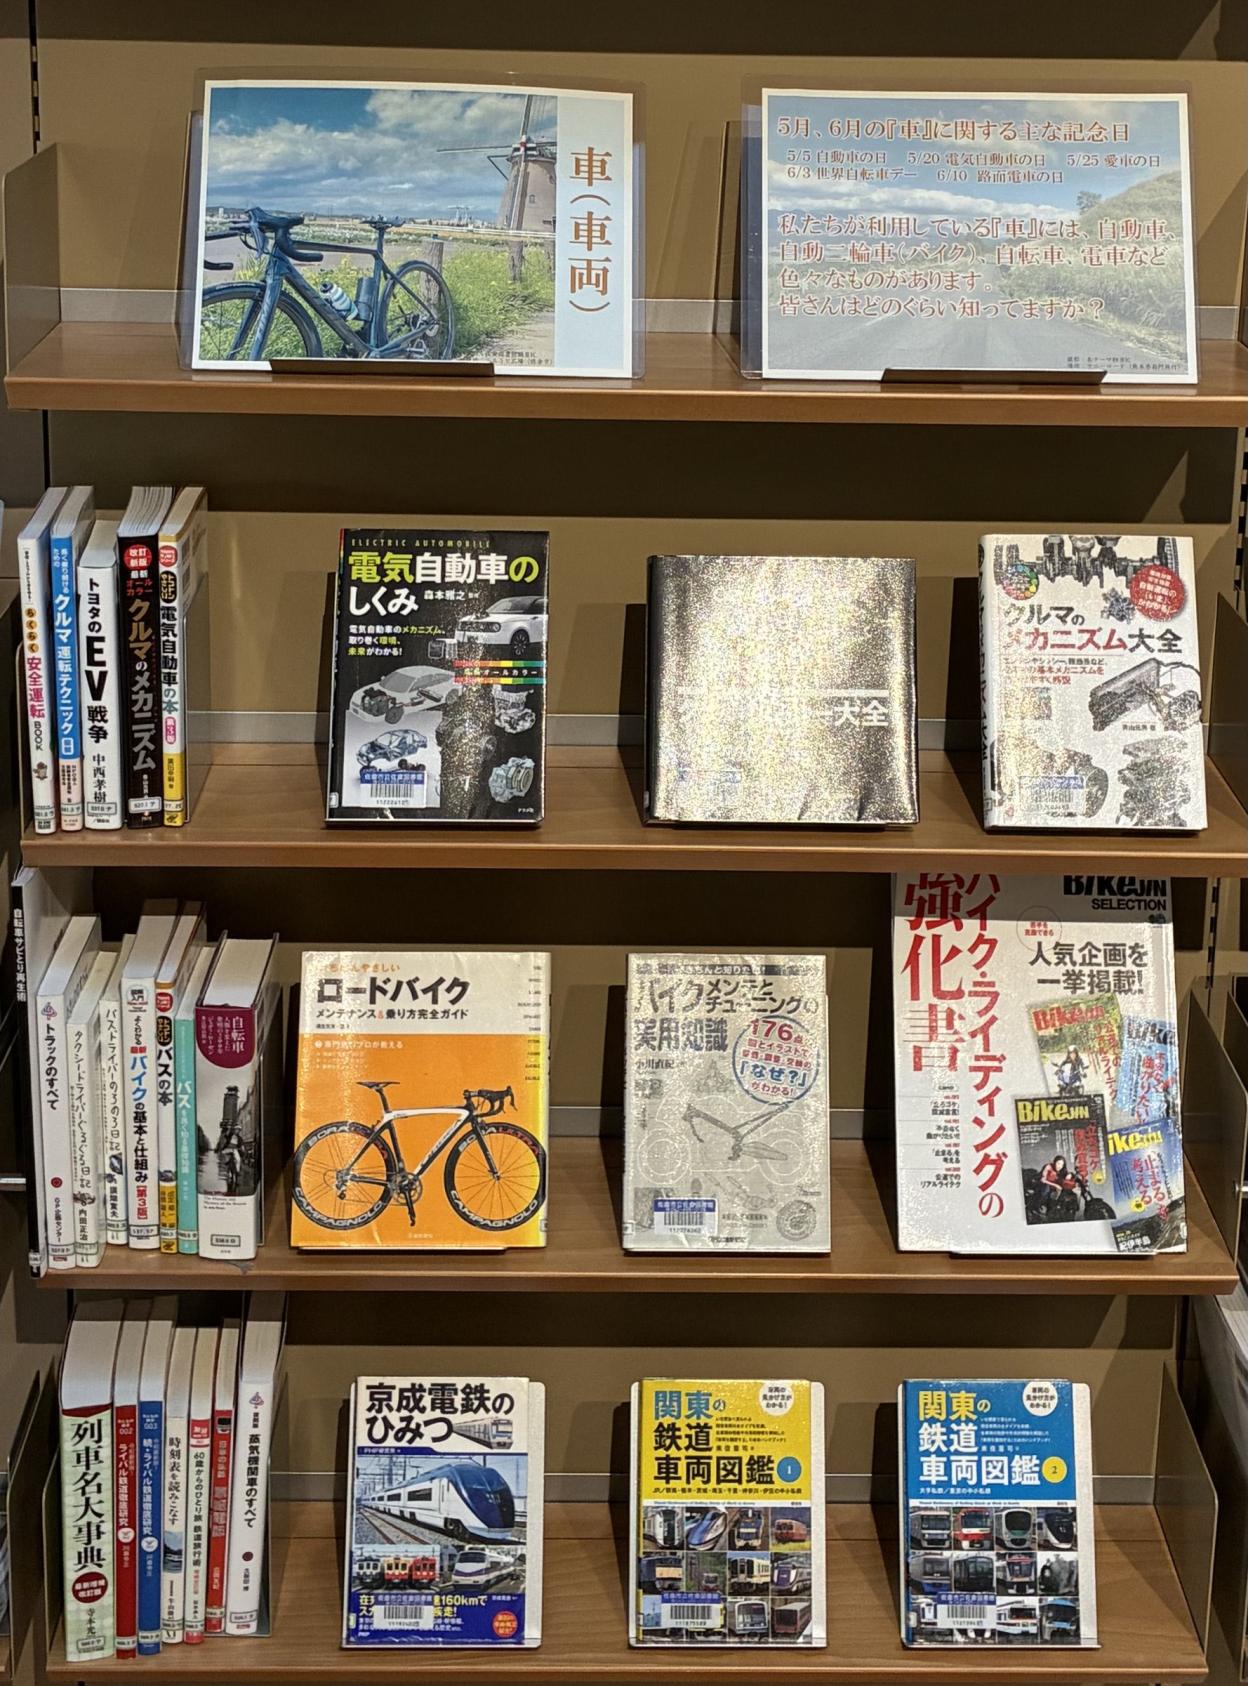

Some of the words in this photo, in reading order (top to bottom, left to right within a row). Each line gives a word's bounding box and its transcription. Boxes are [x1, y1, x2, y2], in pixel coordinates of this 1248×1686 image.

[778, 116, 1131, 143] 5月、6月の『車』に関する主な記念日
[787, 150, 811, 162] 5/5
[816, 150, 887, 164] 自動車の日
[907, 152, 940, 165] 5/20
[945, 152, 1046, 167] 電気自動車の日
[1067, 153, 1099, 166] 5/25
[1104, 153, 1161, 168] 愛車の日
[787, 167, 811, 179] 6/3
[816, 167, 917, 181] 世界自転車デー
[937, 170, 968, 182] 6/10
[976, 170, 1064, 184] 路面電車の日
[569, 146, 612, 312] 車（車両）
[778, 269, 992, 291] 色々なものがあります。
[352, 539, 406, 547] ELECTRIC
[415, 539, 490, 548] AUTOMOBILE
[348, 552, 540, 584] 電気自動車の
[350, 586, 419, 616] しくみ
[54, 594, 74, 735] クルマ運転テクニック
[85, 578, 109, 744] トヨタのEV戦争
[160, 605, 179, 714] 電気自動車の本
[128, 599, 156, 771] クルマのメカニズム
[1092, 899, 1167, 911] SELECTION
[1029, 941, 1149, 968] 人気企画を
[901, 873, 967, 1072] 強化書
[318, 977, 470, 1005] ロードバイク
[231, 1016, 245, 1053] 自転車
[45, 1024, 60, 1110] トラックのすべて
[106, 1009, 121, 1151] バスドライバーのろのろ日記
[157, 1047, 172, 1106] バスの本
[74, 1031, 91, 1188] タクシードライバーぐるぐる日記
[308, 1126, 350, 1147] BORA
[295, 1187, 384, 1227] CAMPAGNOLO
[451, 1190, 538, 1228] CAMPAGNOLO
[366, 1382, 515, 1415] 京成電鉄の
[653, 1390, 726, 1421] 関東の
[918, 1390, 991, 1421] 関東の
[366, 1415, 454, 1445] ひみつ
[653, 1422, 713, 1452] 鉄道
[918, 1422, 979, 1453] 鉄道
[244, 1434, 262, 1528] 蒸気機関車のすべて
[653, 1455, 776, 1485] 車両図鑑
[919, 1455, 1041, 1486] 車両図鑑
[70, 1418, 107, 1573] 列車名大事典
